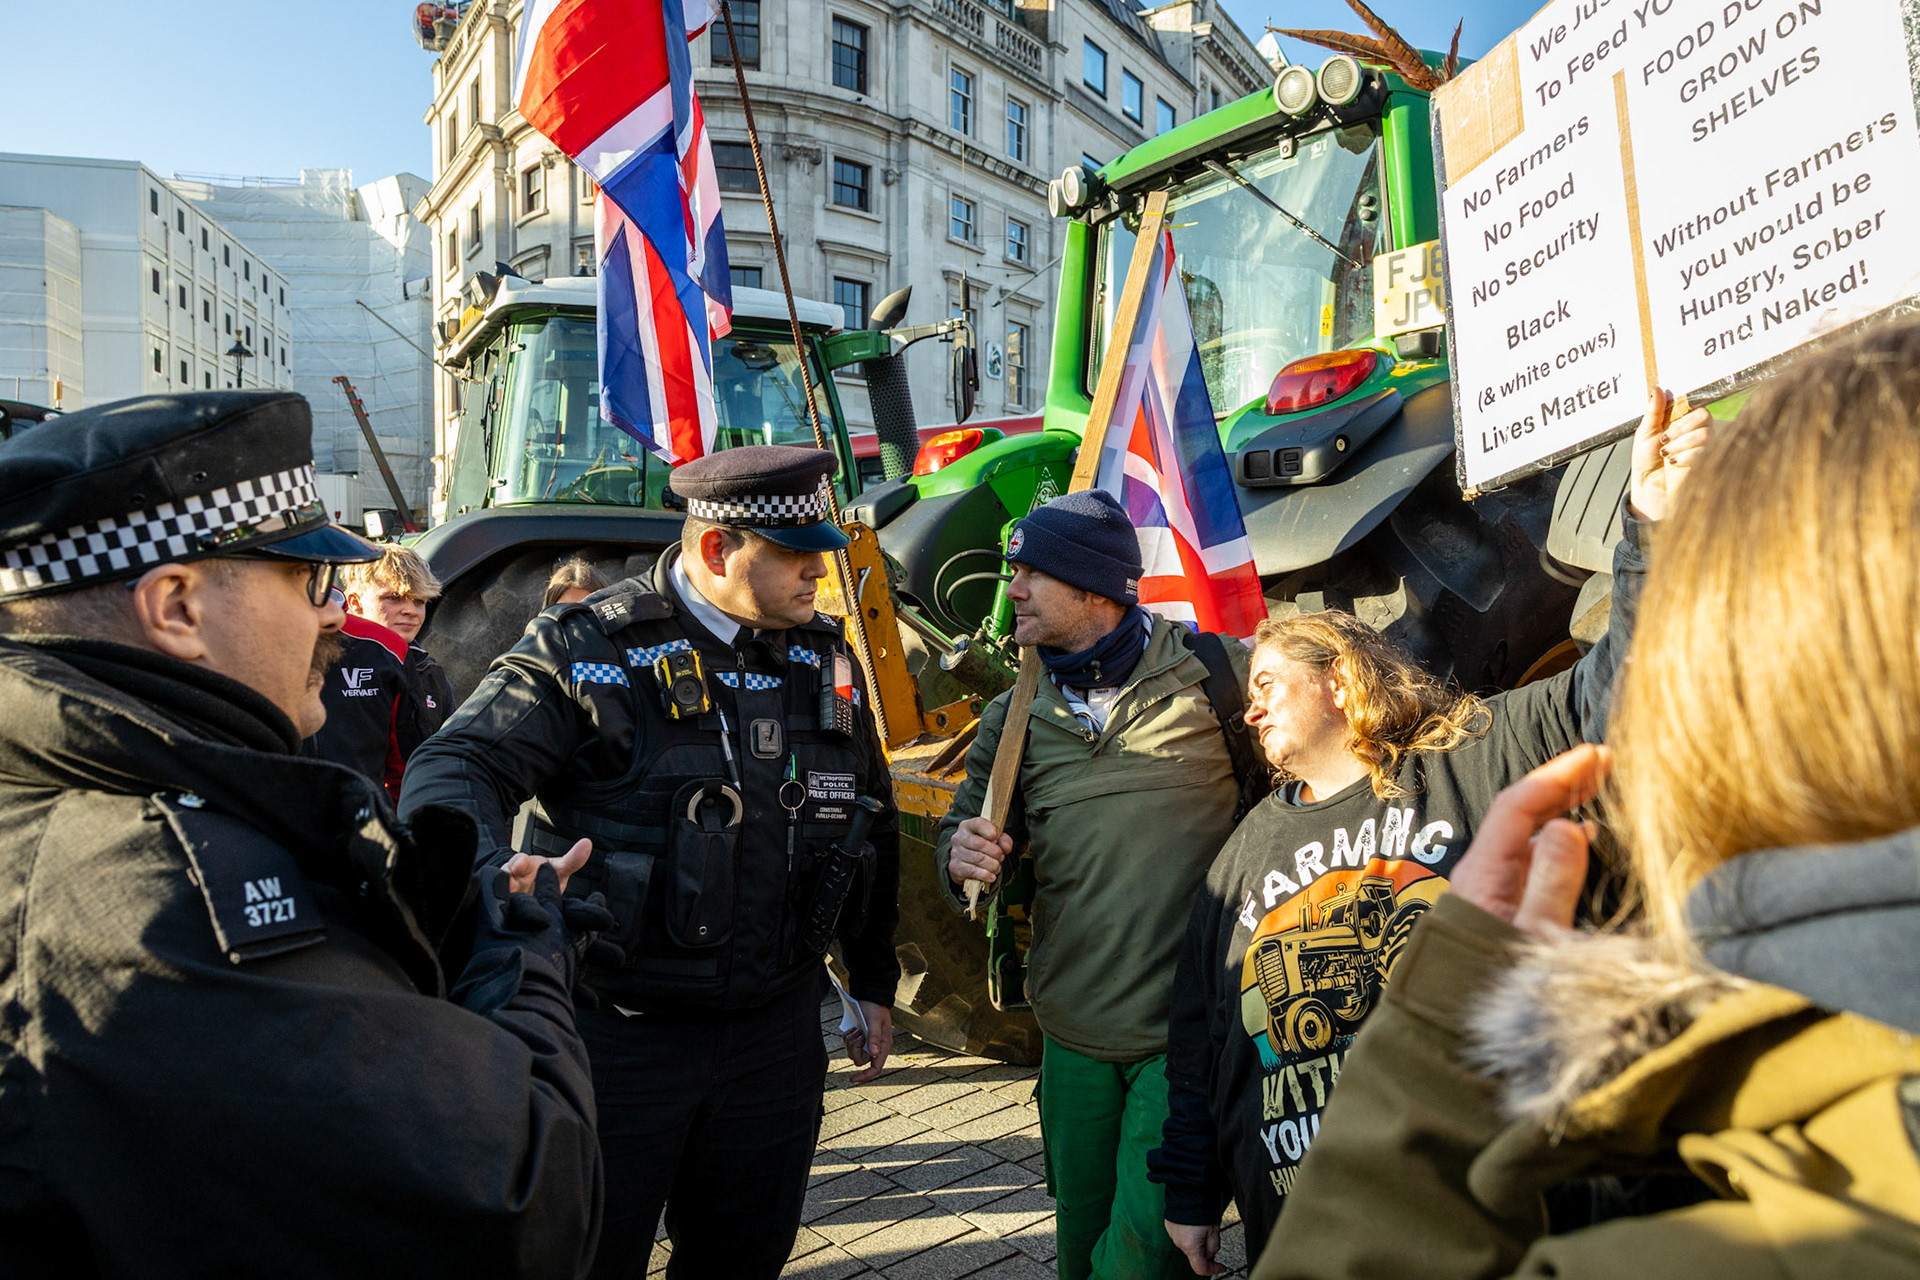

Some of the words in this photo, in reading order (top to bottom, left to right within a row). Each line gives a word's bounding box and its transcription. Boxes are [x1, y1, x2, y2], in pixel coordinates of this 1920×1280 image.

[1530, 24, 1567, 61] We
[1573, 0, 1611, 30] Ju
[1535, 79, 1562, 107] To
[1567, 19, 1628, 85] Feed
[1643, 20, 1715, 87] FOOD
[1680, 28, 1766, 103] GROW
[1775, 0, 1822, 39] ON
[1692, 46, 1821, 143] SHELVES
[1463, 191, 1492, 219] No
[1495, 115, 1589, 195] Farmers
[1652, 186, 1759, 258] Without
[1764, 112, 1898, 198] Farmers
[1484, 221, 1512, 252] No
[1519, 172, 1575, 228] Food
[1680, 248, 1728, 290] you
[1733, 191, 1823, 257] would
[1832, 172, 1872, 206] be
[1472, 278, 1501, 308] No
[1505, 212, 1599, 286] Security
[1680, 264, 1785, 326] Hungry,
[1792, 209, 1887, 270] Sober
[1506, 299, 1572, 350] Black
[1703, 315, 1754, 356] and
[1761, 260, 1870, 331] Naked!
[1478, 386, 1497, 413] (&
[1500, 362, 1551, 398] white
[1555, 323, 1616, 370] cows)
[1482, 415, 1536, 453] Lives
[1540, 373, 1622, 427] Matter
[612, 602, 628, 615] AW
[341, 667, 374, 689] VF
[341, 688, 379, 697] VERVAET
[808, 789, 828, 799] POLICE
[829, 791, 855, 800] OFFICER
[244, 876, 282, 903] AW
[244, 897, 296, 927] 3727
